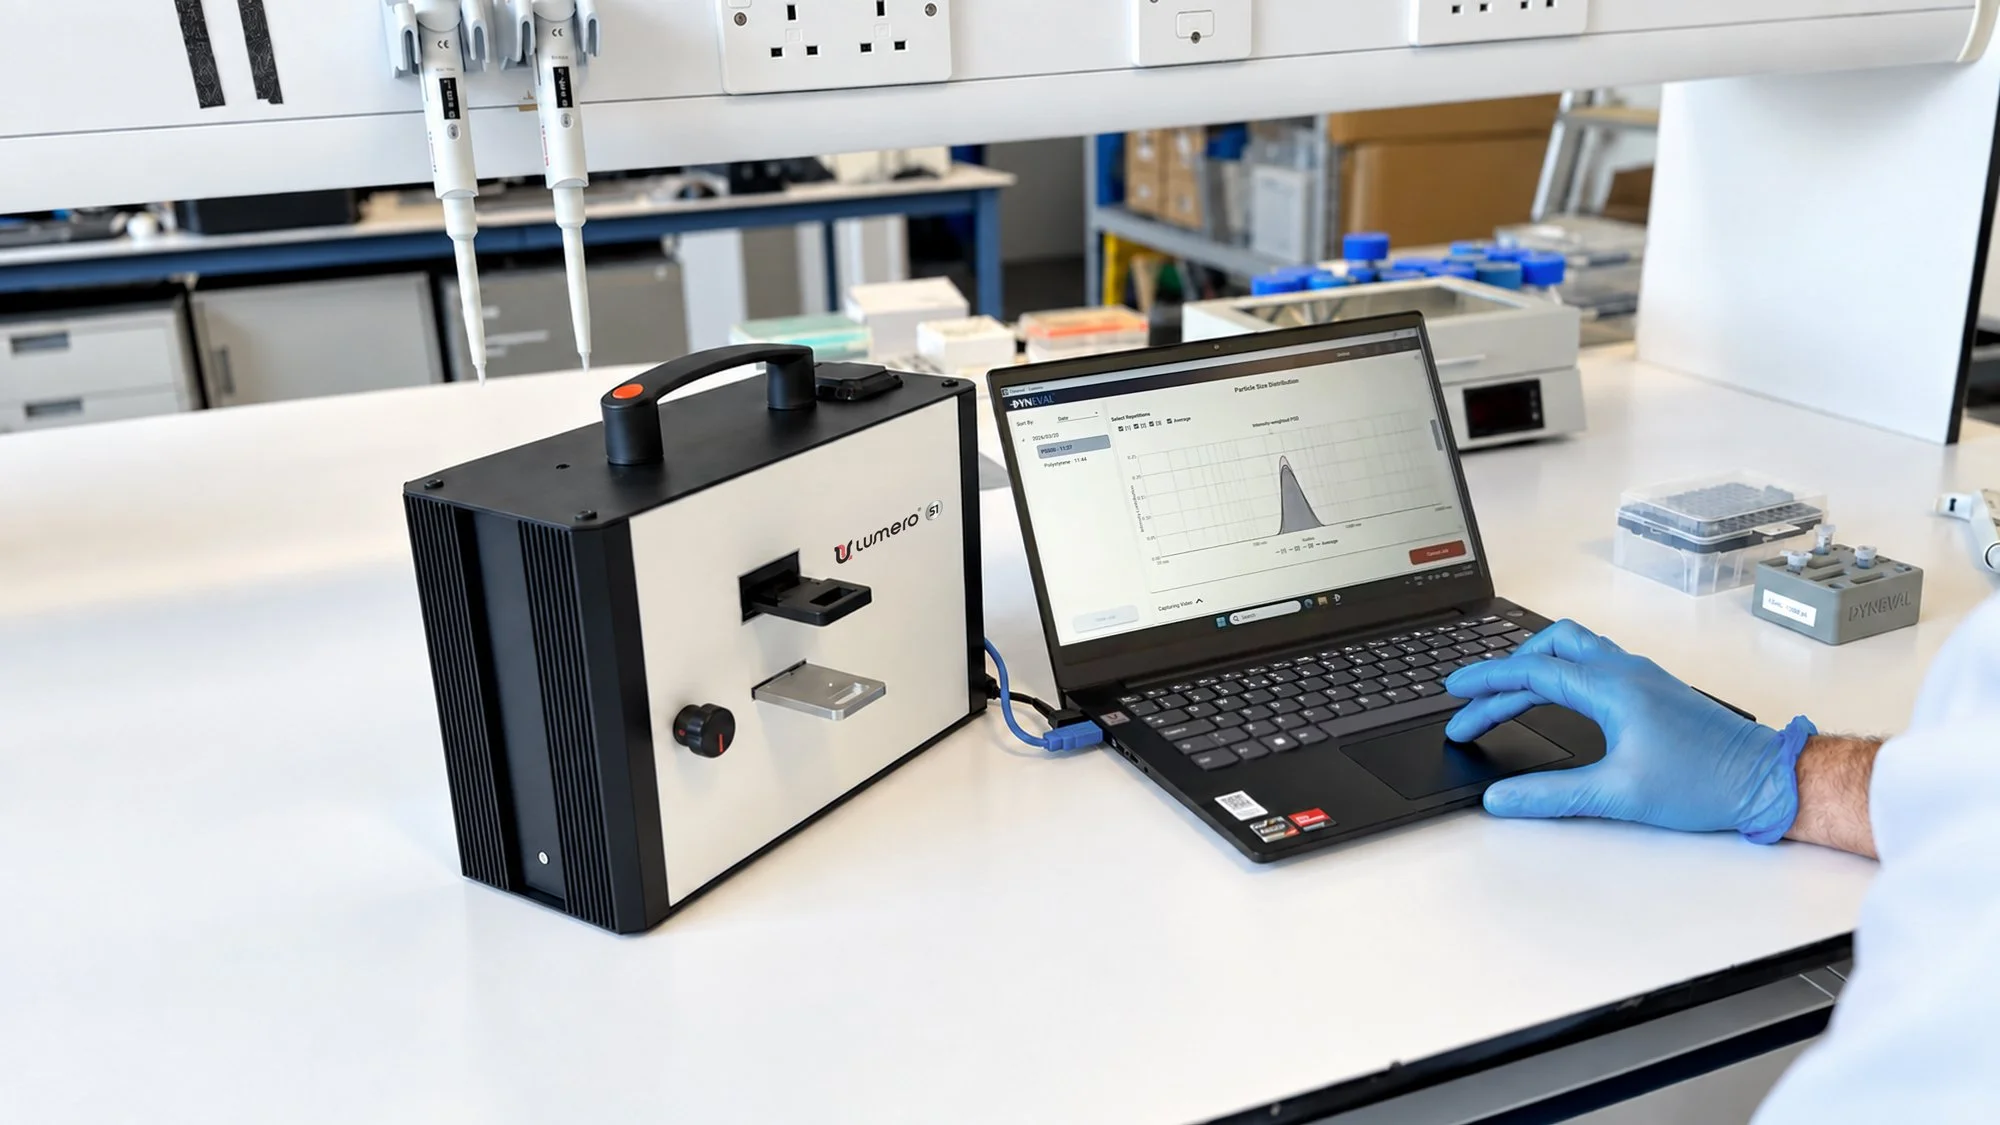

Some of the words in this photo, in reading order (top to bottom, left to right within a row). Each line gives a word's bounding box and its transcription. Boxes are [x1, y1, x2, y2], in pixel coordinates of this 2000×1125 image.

[1268, 378, 1299, 388] Distribution
[1010, 394, 1054, 408] DYNEVAL
[1126, 412, 1150, 420] Repetitions
[1158, 602, 1180, 611] Capturing
[1849, 591, 1911, 622] DYNEVAL
[1241, 612, 1256, 620] Search
